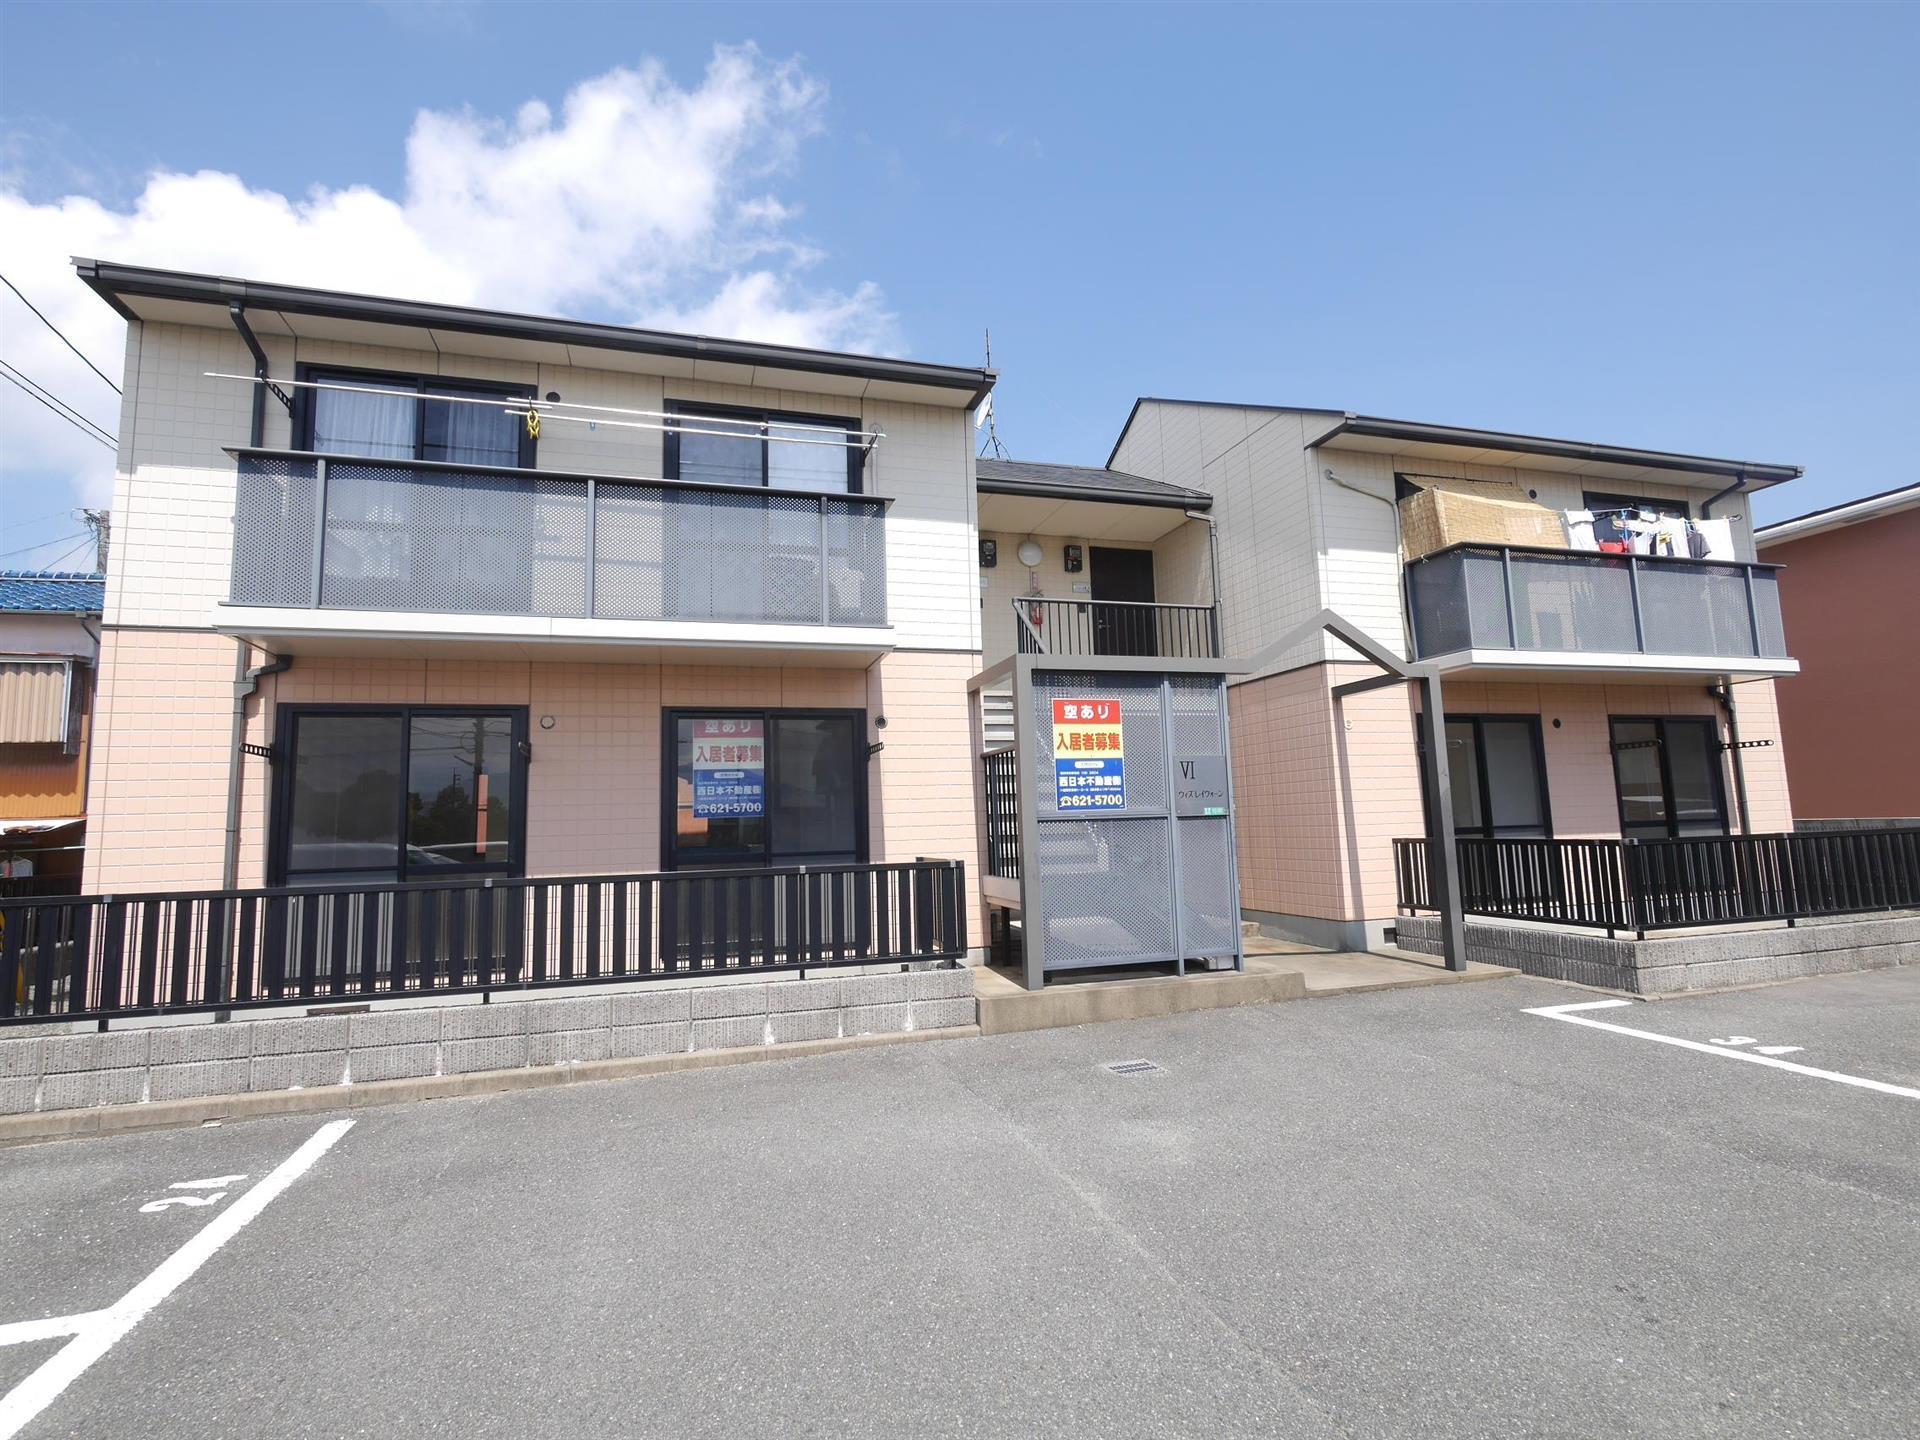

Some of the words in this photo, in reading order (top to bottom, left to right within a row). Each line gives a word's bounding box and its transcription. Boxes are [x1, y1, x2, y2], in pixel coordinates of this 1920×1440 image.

[1063, 703, 1110, 719] 空あり
[1056, 732, 1120, 751] 入居者募集
[695, 745, 762, 762] 入居者募集
[710, 802, 762, 813] 621-5700
[1072, 794, 1123, 806] 621-5700
